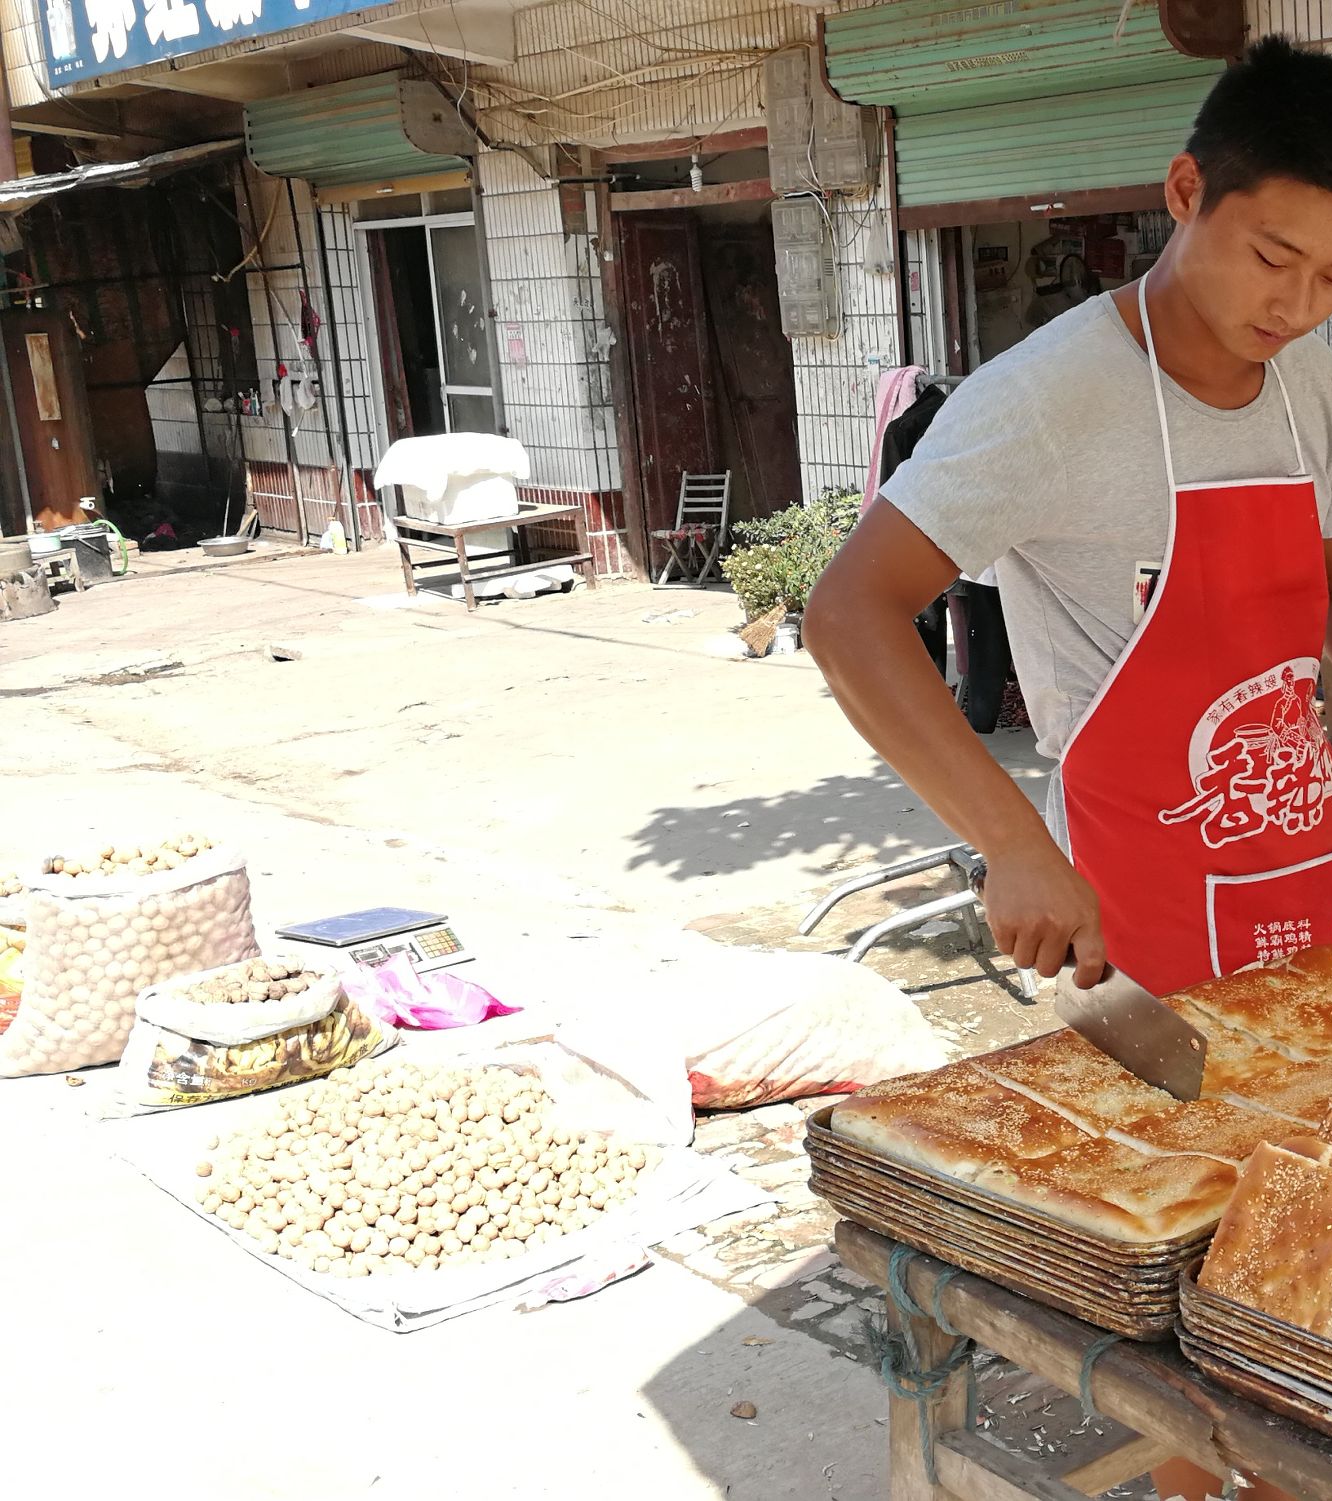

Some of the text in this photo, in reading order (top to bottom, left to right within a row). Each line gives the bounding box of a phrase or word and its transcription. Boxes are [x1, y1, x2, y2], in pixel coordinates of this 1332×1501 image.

[1253, 918, 1312, 936] 火锅底料
[1254, 930, 1313, 949] 鲜霸鸡精
